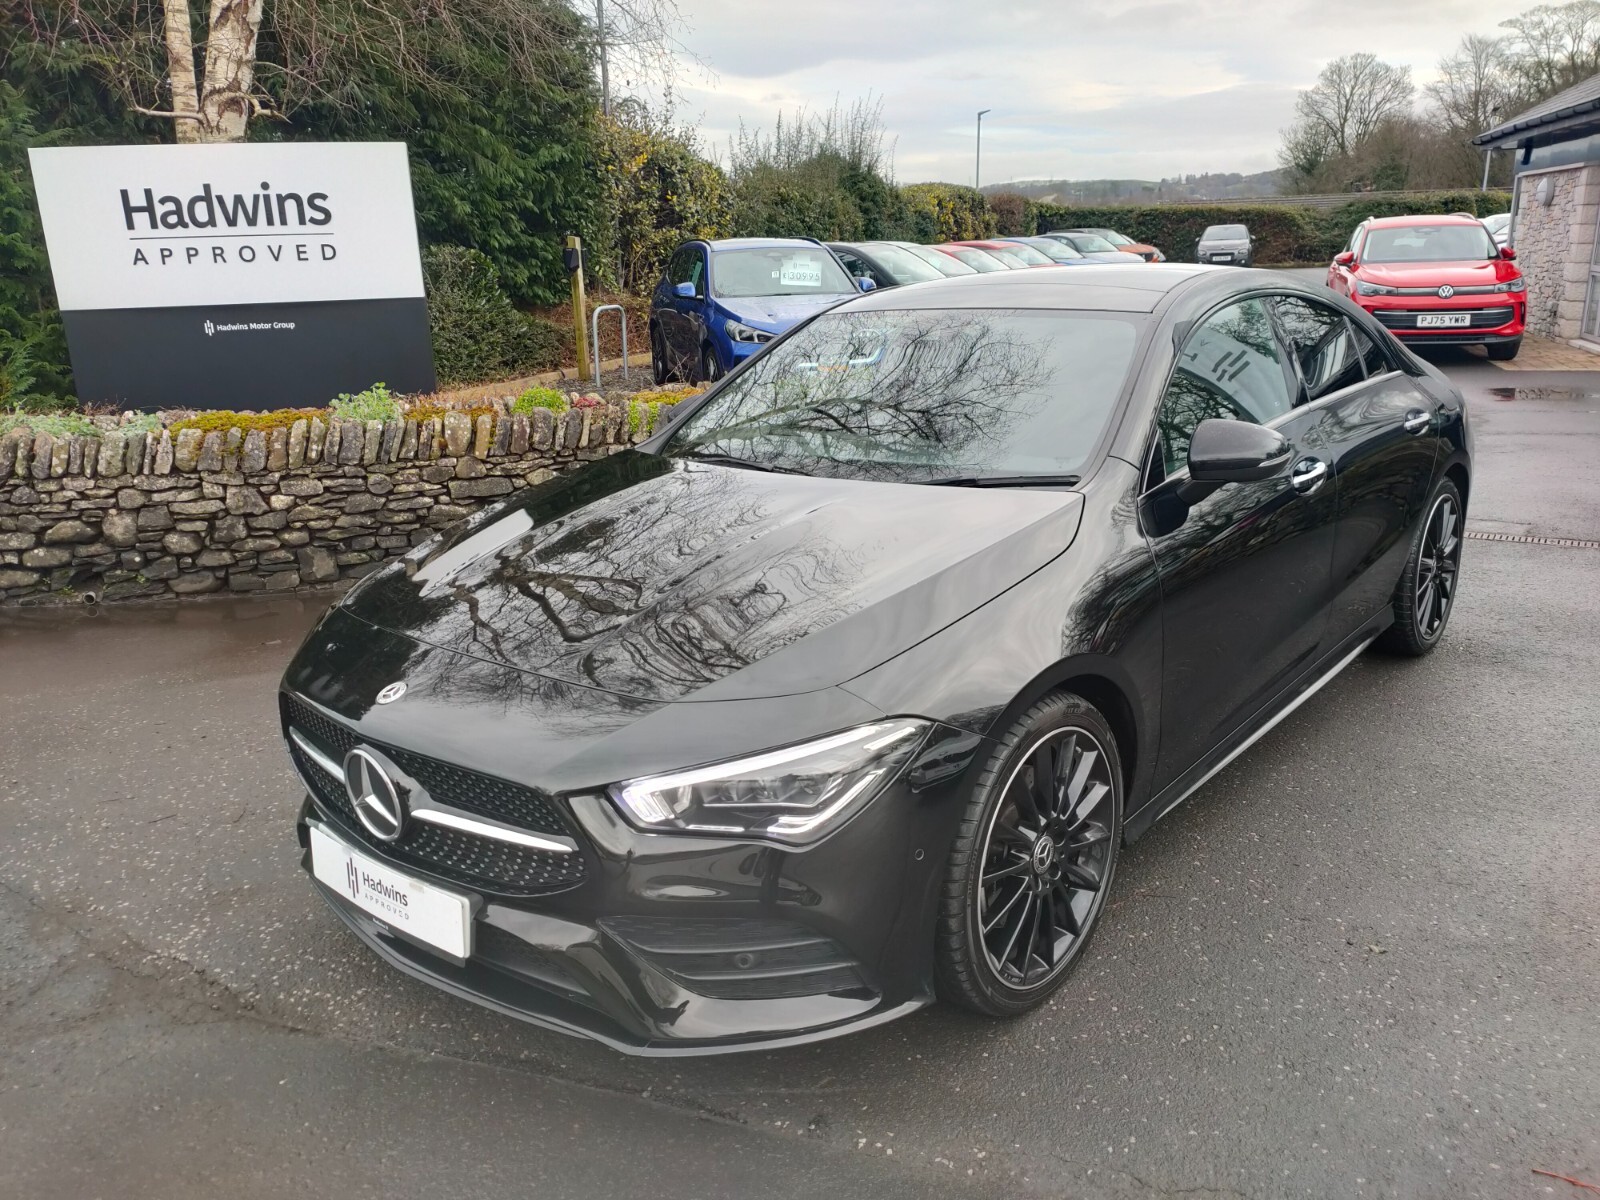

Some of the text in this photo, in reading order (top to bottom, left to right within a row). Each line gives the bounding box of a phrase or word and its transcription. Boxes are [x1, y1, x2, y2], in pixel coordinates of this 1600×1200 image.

[120, 181, 332, 231] Hadwins
[133, 243, 337, 265] APPROVED
[216, 321, 296, 331] Hadwins Motor Group
[1421, 315, 1467, 325] PJ75 YWR
[362, 871, 408, 907] Hadwins
[365, 893, 410, 920] APPROVED
